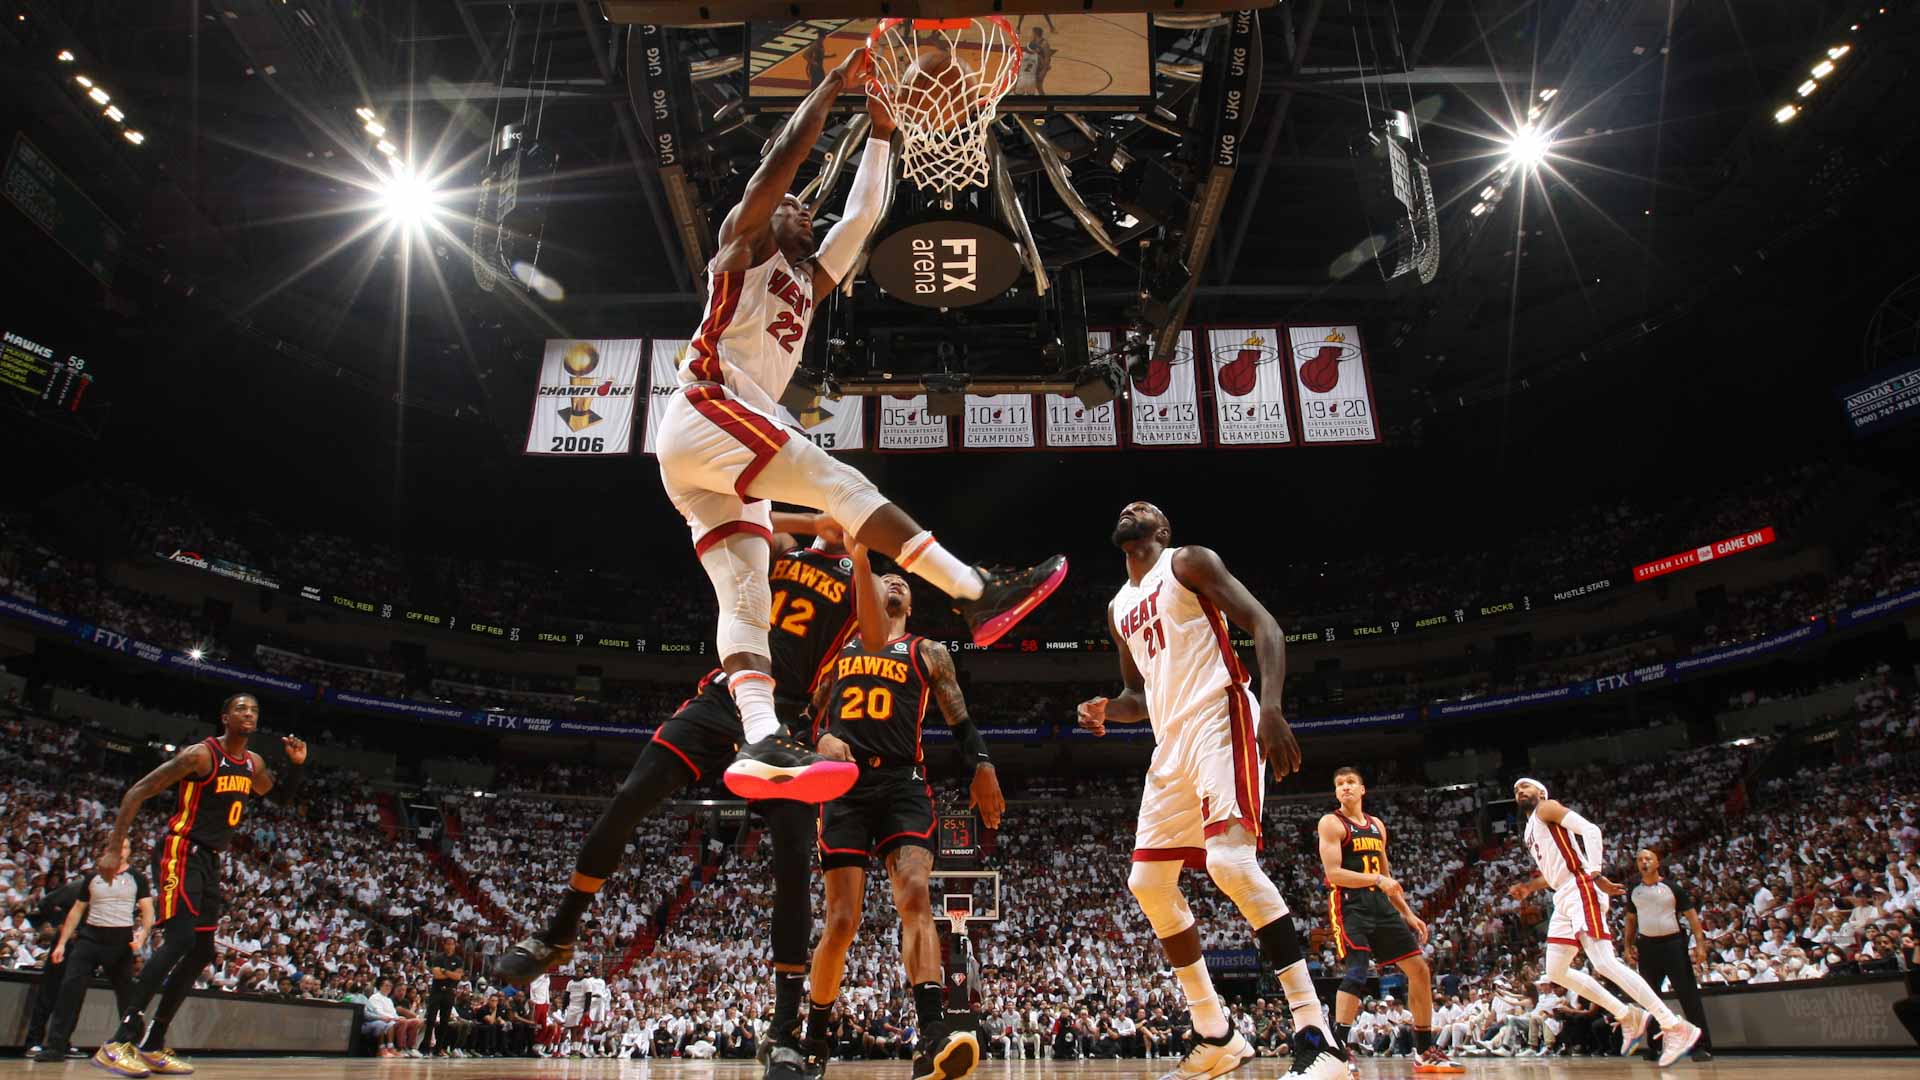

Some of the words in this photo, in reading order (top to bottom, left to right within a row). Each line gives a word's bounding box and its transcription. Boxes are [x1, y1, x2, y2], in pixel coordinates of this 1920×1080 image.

[912, 239, 936, 294] arena
[942, 238, 977, 292] FTX
[766, 311, 803, 354] 22
[4, 331, 54, 358] HAWKS
[67, 356, 84, 370] 58
[1847, 385, 1892, 409] ANIDJAR
[884, 408, 905, 426] 05
[970, 407, 991, 424] 10
[1008, 407, 1026, 424] 11
[1051, 406, 1070, 424] 11
[1136, 404, 1154, 422] 12
[1176, 404, 1194, 422] 13
[1222, 404, 1242, 422] 13
[1262, 404, 1281, 421] 14
[1307, 402, 1326, 419] 19
[1344, 400, 1366, 418] 20
[883, 435, 944, 445] CHAMPIONS
[968, 434, 1030, 443] CHAMPIONS
[1050, 434, 1113, 443] CHAMPIONS
[1136, 432, 1198, 441] CHAMPIONS
[1222, 431, 1285, 440] CHAMPIONS
[1308, 427, 1370, 437] CHAMPIONS
[551, 436, 604, 452] 2006
[1639, 560, 1672, 576] STREAM
[1675, 554, 1694, 566] LIVE
[1717, 538, 1745, 554] GAME
[1747, 532, 1763, 546] ON
[771, 560, 846, 603] HAWKS
[1554, 586, 1585, 600] HUSTLE
[1587, 580, 1610, 592] STATS
[332, 596, 356, 608] TOTAL
[356, 602, 374, 612] REB
[1121, 580, 1164, 640] HEAT
[1481, 602, 1514, 615] BLOCKS
[406, 612, 422, 620] OFF
[424, 614, 440, 624] REB
[769, 590, 815, 636] 12
[471, 624, 486, 632] DEF
[488, 626, 504, 636] REB
[1416, 616, 1447, 628] ASSISTS
[538, 634, 567, 642] STEALS
[1144, 619, 1166, 659] 21
[1353, 626, 1382, 636] STEALS
[94, 628, 128, 652] FTX
[599, 639, 630, 648] ASSISTS
[1046, 641, 1078, 650] HAWKS
[1239, 639, 1254, 647] REB
[1286, 634, 1300, 642] DEF
[1302, 633, 1318, 641] REB
[838, 656, 908, 684] HAWKS
[1596, 672, 1630, 693] FTX
[841, 686, 893, 720] 20
[486, 714, 516, 730] FTX
[523, 718, 552, 726] MIAMI
[528, 724, 553, 732] HEAT
[216, 776, 252, 793] HAWK
[229, 800, 242, 826] 0
[1535, 844, 1542, 861] 2
[1362, 856, 1380, 874] 13
[1206, 954, 1256, 967] tmaster
